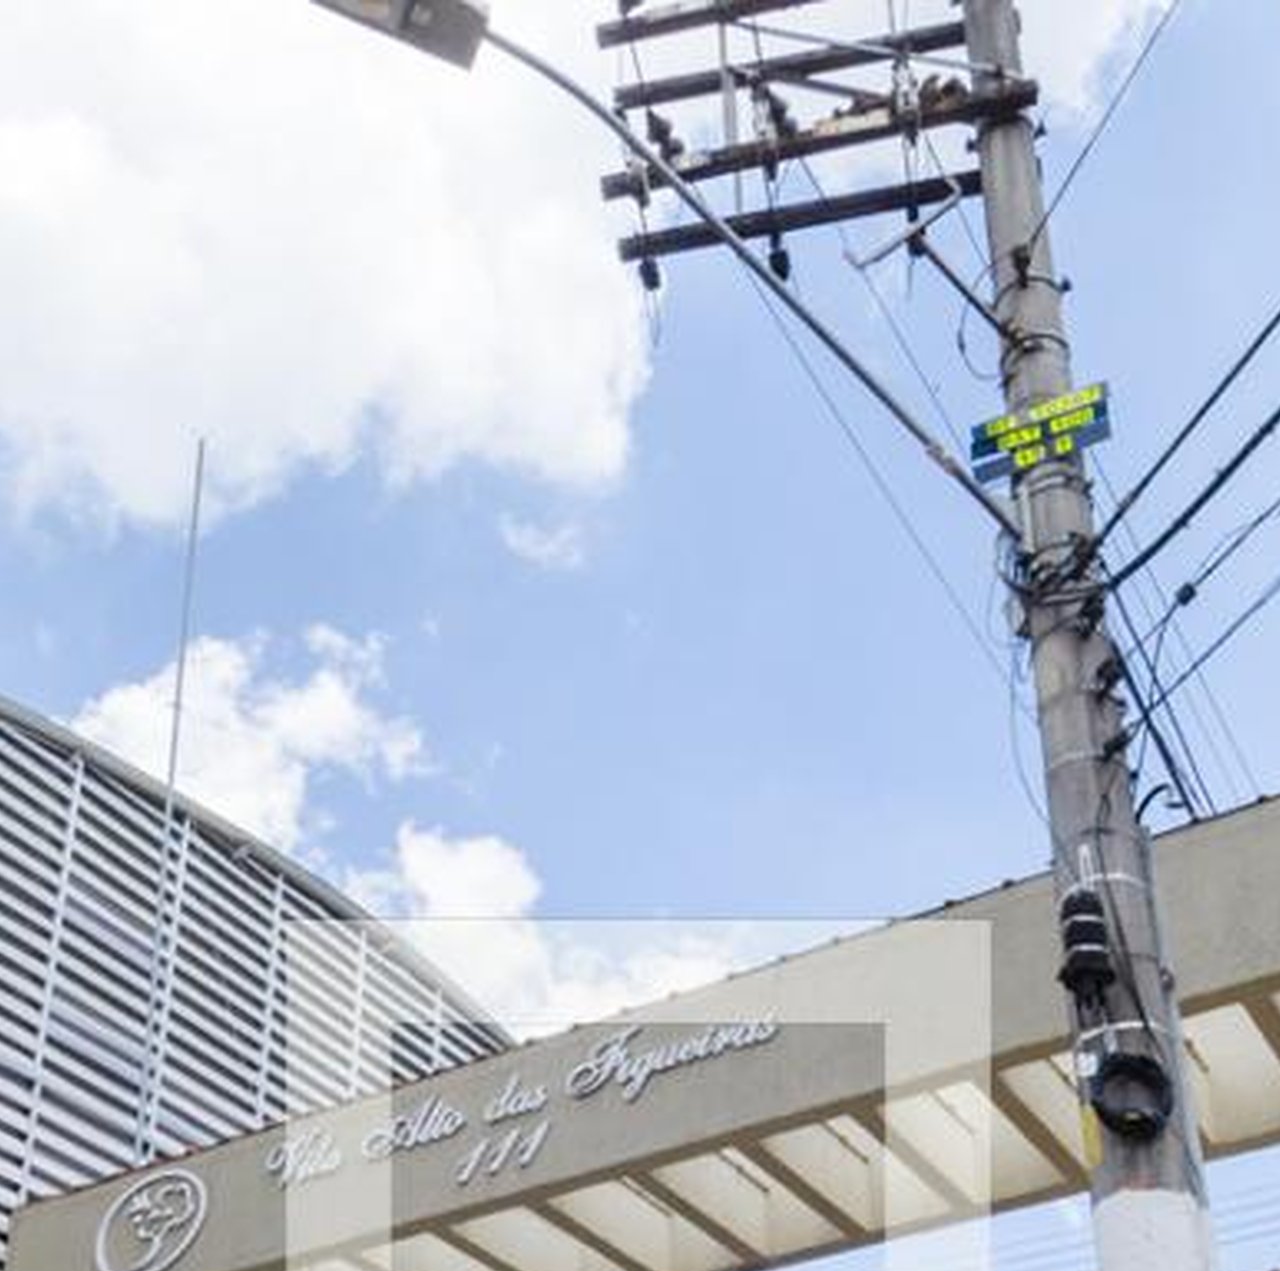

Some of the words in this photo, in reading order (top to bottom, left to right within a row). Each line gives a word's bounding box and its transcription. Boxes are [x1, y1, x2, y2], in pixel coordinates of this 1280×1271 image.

[362, 1096, 467, 1158] Alto
[483, 1073, 548, 1124] das
[567, 1013, 779, 1103] Figueiras
